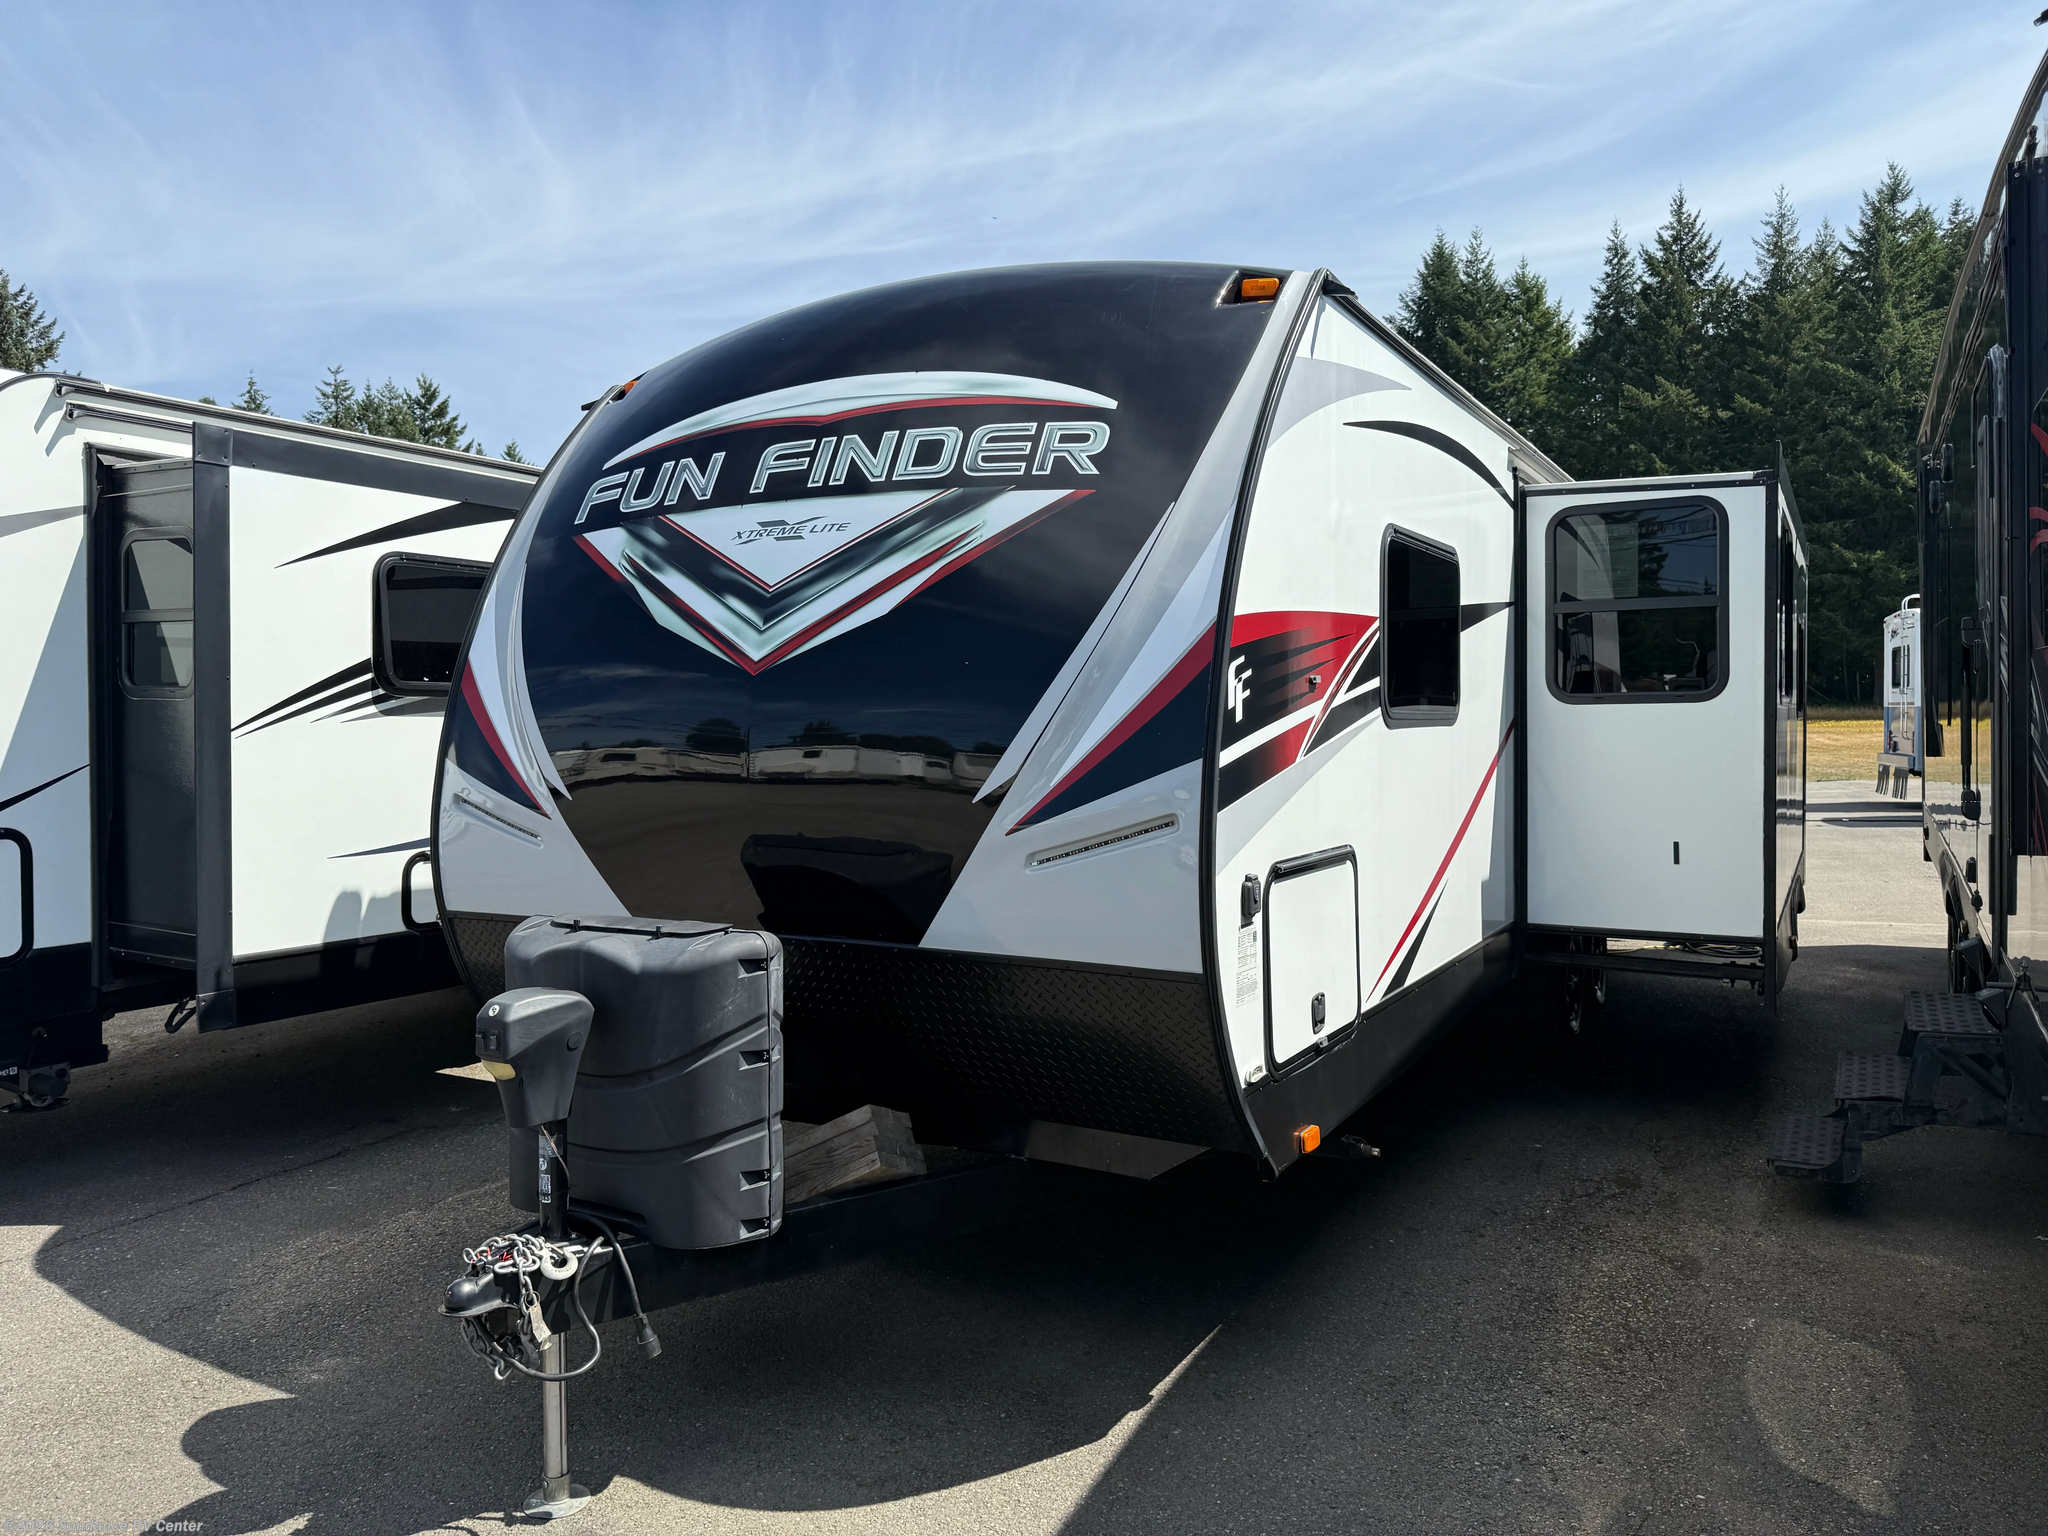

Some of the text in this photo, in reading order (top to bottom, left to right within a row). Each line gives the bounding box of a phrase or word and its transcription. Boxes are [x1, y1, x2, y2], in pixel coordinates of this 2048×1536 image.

[574, 421, 1111, 525] FUN FINDER
[731, 522, 851, 540] XTREME LITE
